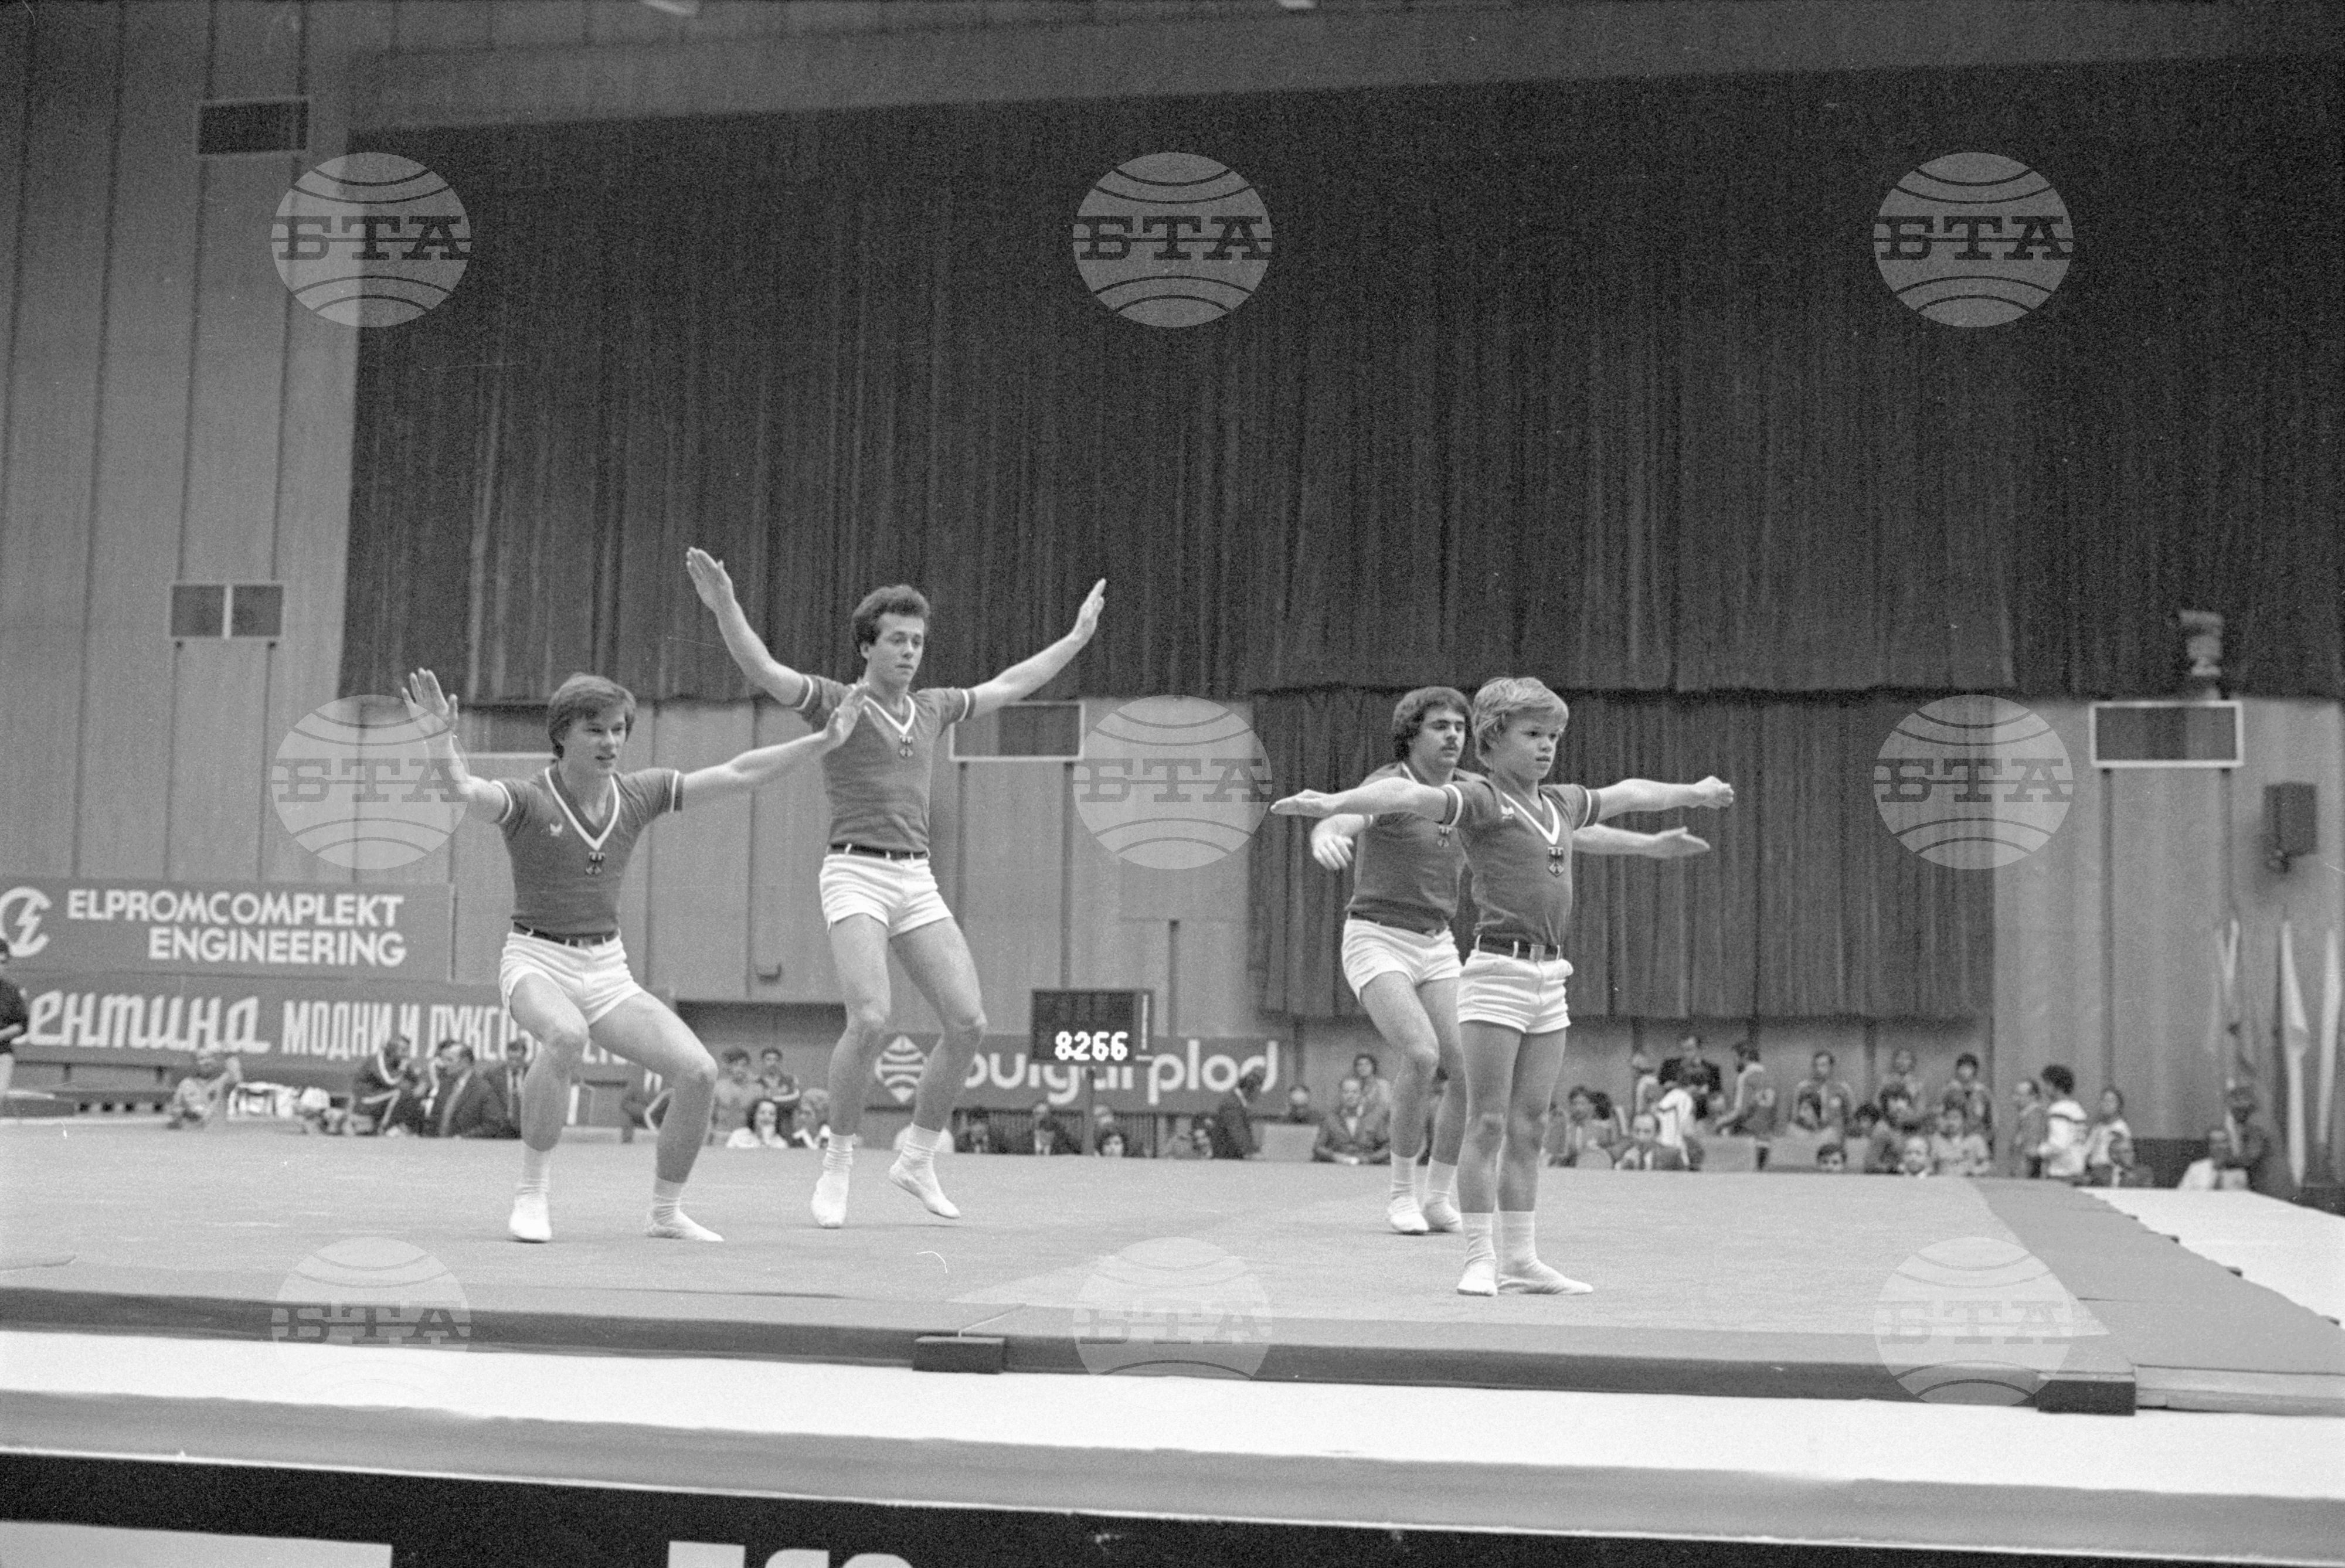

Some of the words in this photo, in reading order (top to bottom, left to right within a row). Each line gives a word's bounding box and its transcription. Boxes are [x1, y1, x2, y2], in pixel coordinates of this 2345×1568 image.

[67, 889, 405, 927] ELPROMCOMPLEKT
[148, 926, 407, 967] ENGINEERING
[12, 989, 271, 1053] ентина
[281, 999, 392, 1060] МОДНИ
[1055, 1030, 1128, 1060] 8266
